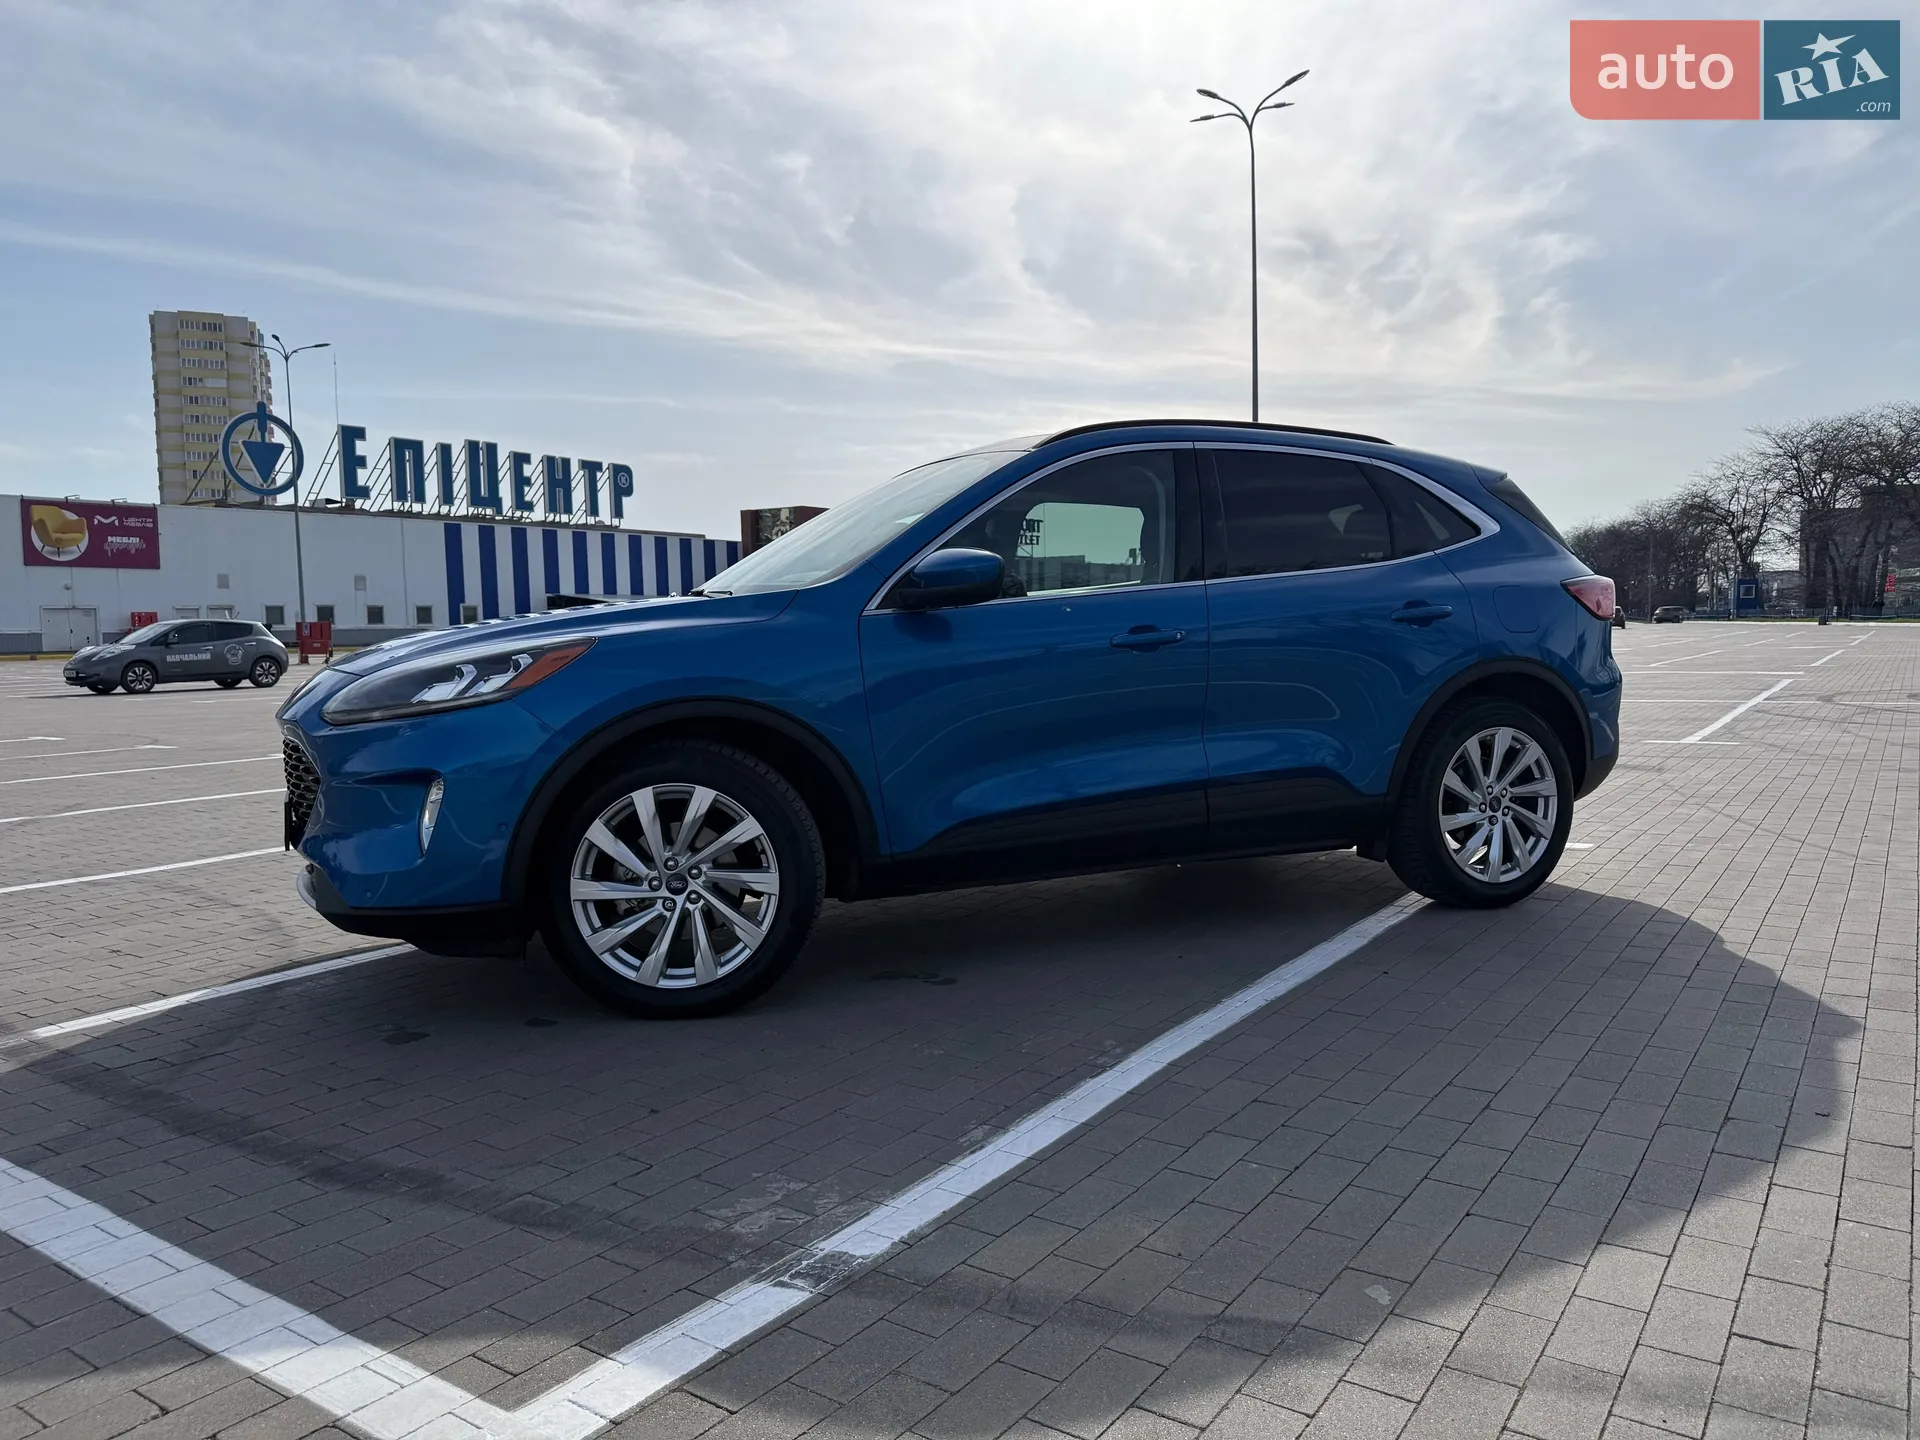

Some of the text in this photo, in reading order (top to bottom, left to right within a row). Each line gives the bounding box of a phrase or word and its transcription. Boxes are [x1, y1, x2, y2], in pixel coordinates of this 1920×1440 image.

[338, 424, 634, 519] ЕПІЦЕНТР
[1021, 519, 1043, 533] ORT
[1019, 535, 1040, 545] TLET
[166, 652, 211, 662] НАВЧАЛЬНИЙ
